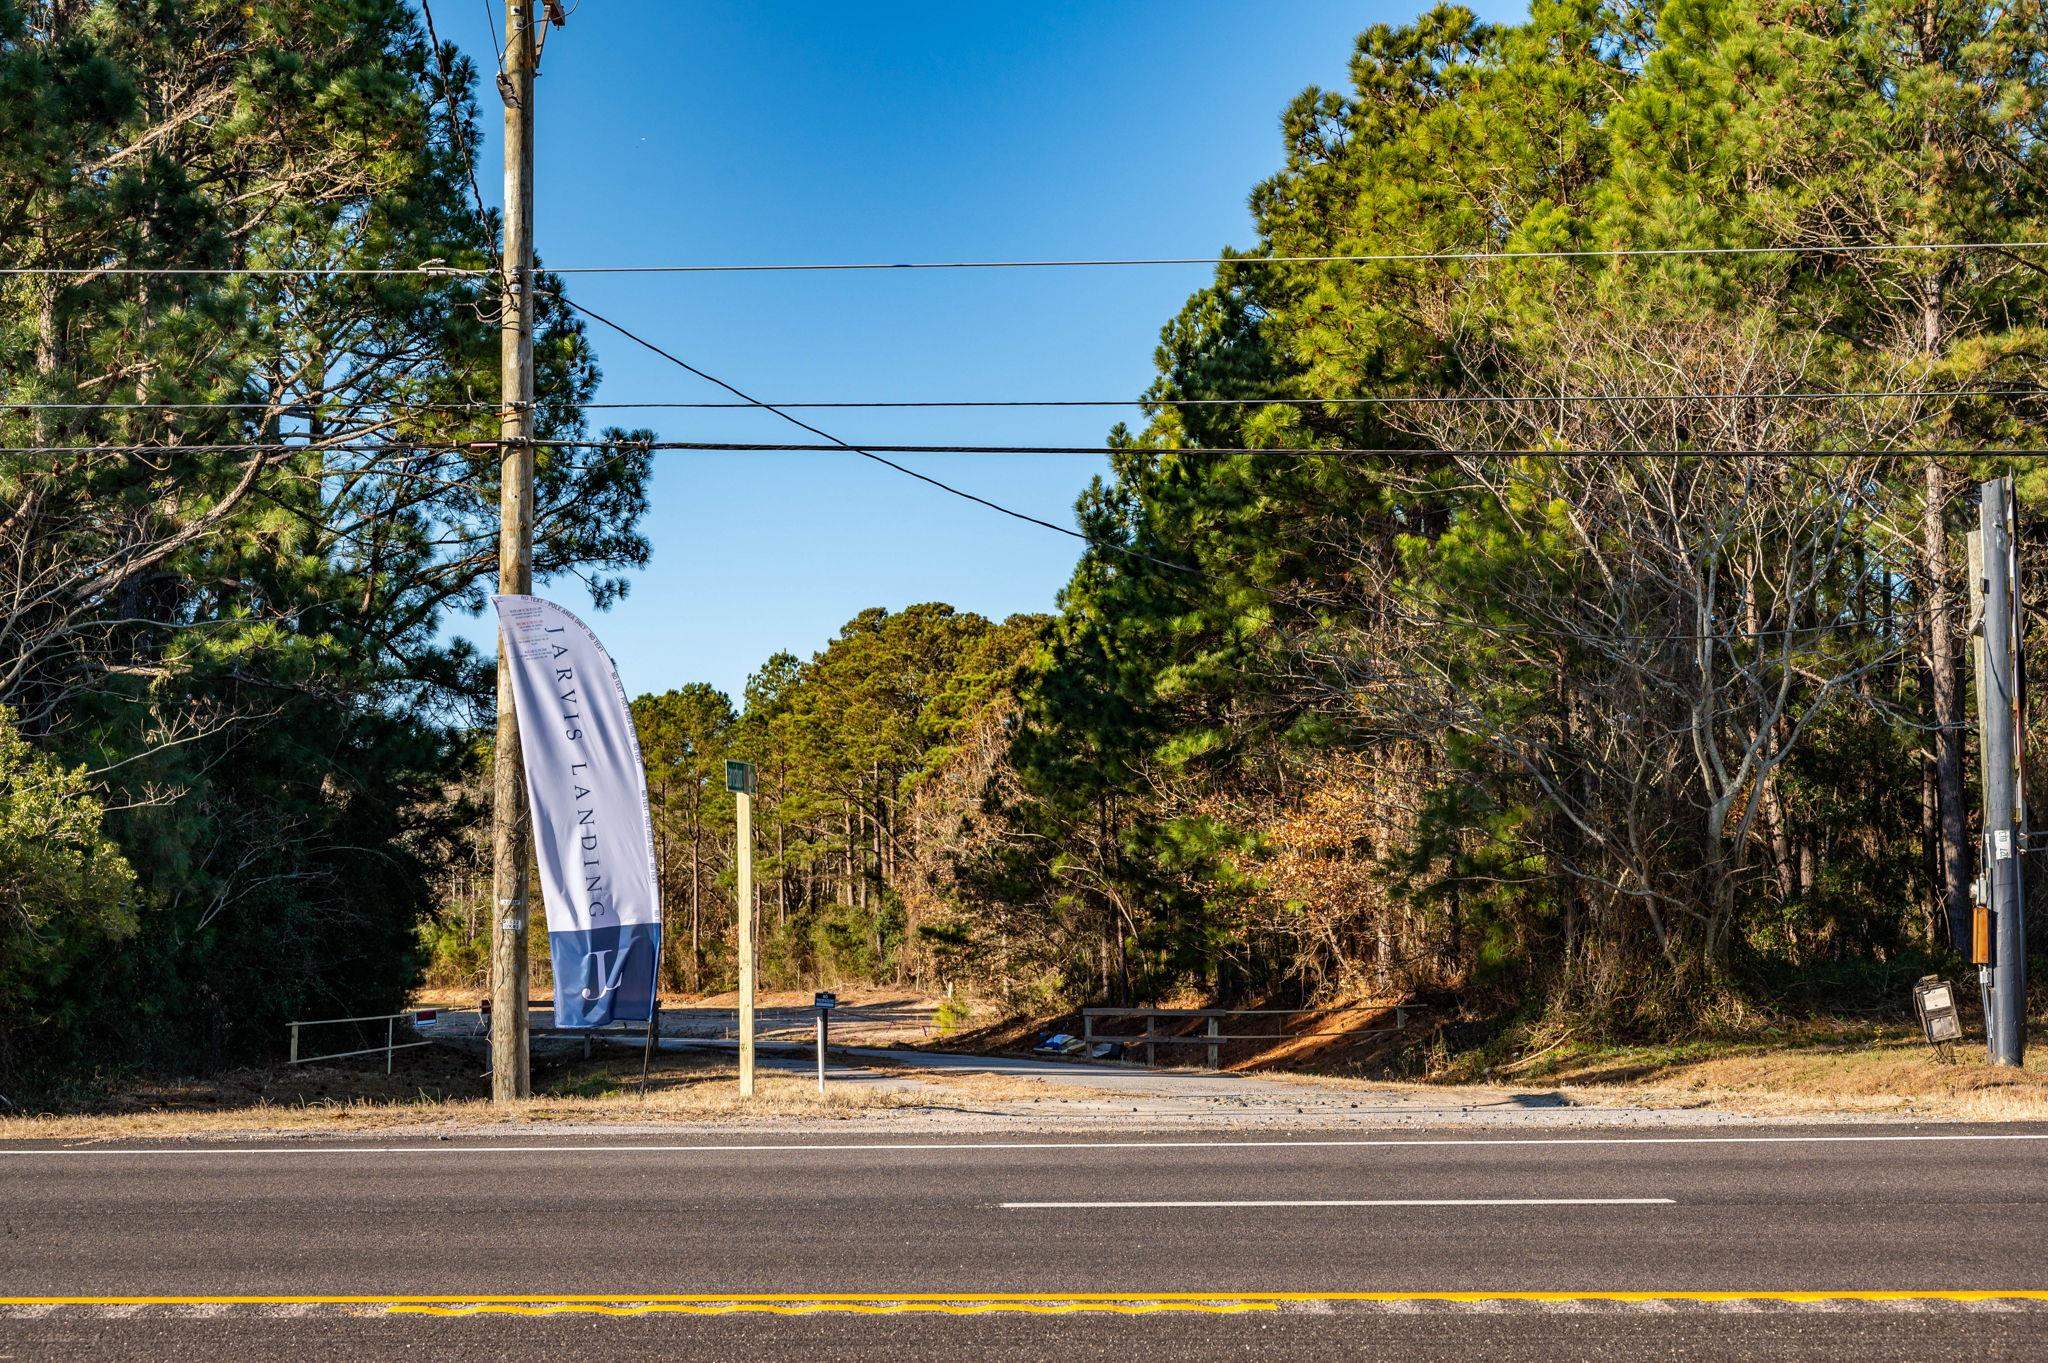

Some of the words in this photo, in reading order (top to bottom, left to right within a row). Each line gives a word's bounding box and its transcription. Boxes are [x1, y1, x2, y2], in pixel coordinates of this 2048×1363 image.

[530, 596, 544, 604] TEXT
[547, 601, 561, 612] POLE
[561, 608, 576, 621] AREA
[574, 617, 587, 631] ONLY
[587, 632, 596, 641] NO
[593, 639, 604, 652] TEXT
[545, 625, 583, 741] JARVIS
[571, 761, 605, 918] LANDING
